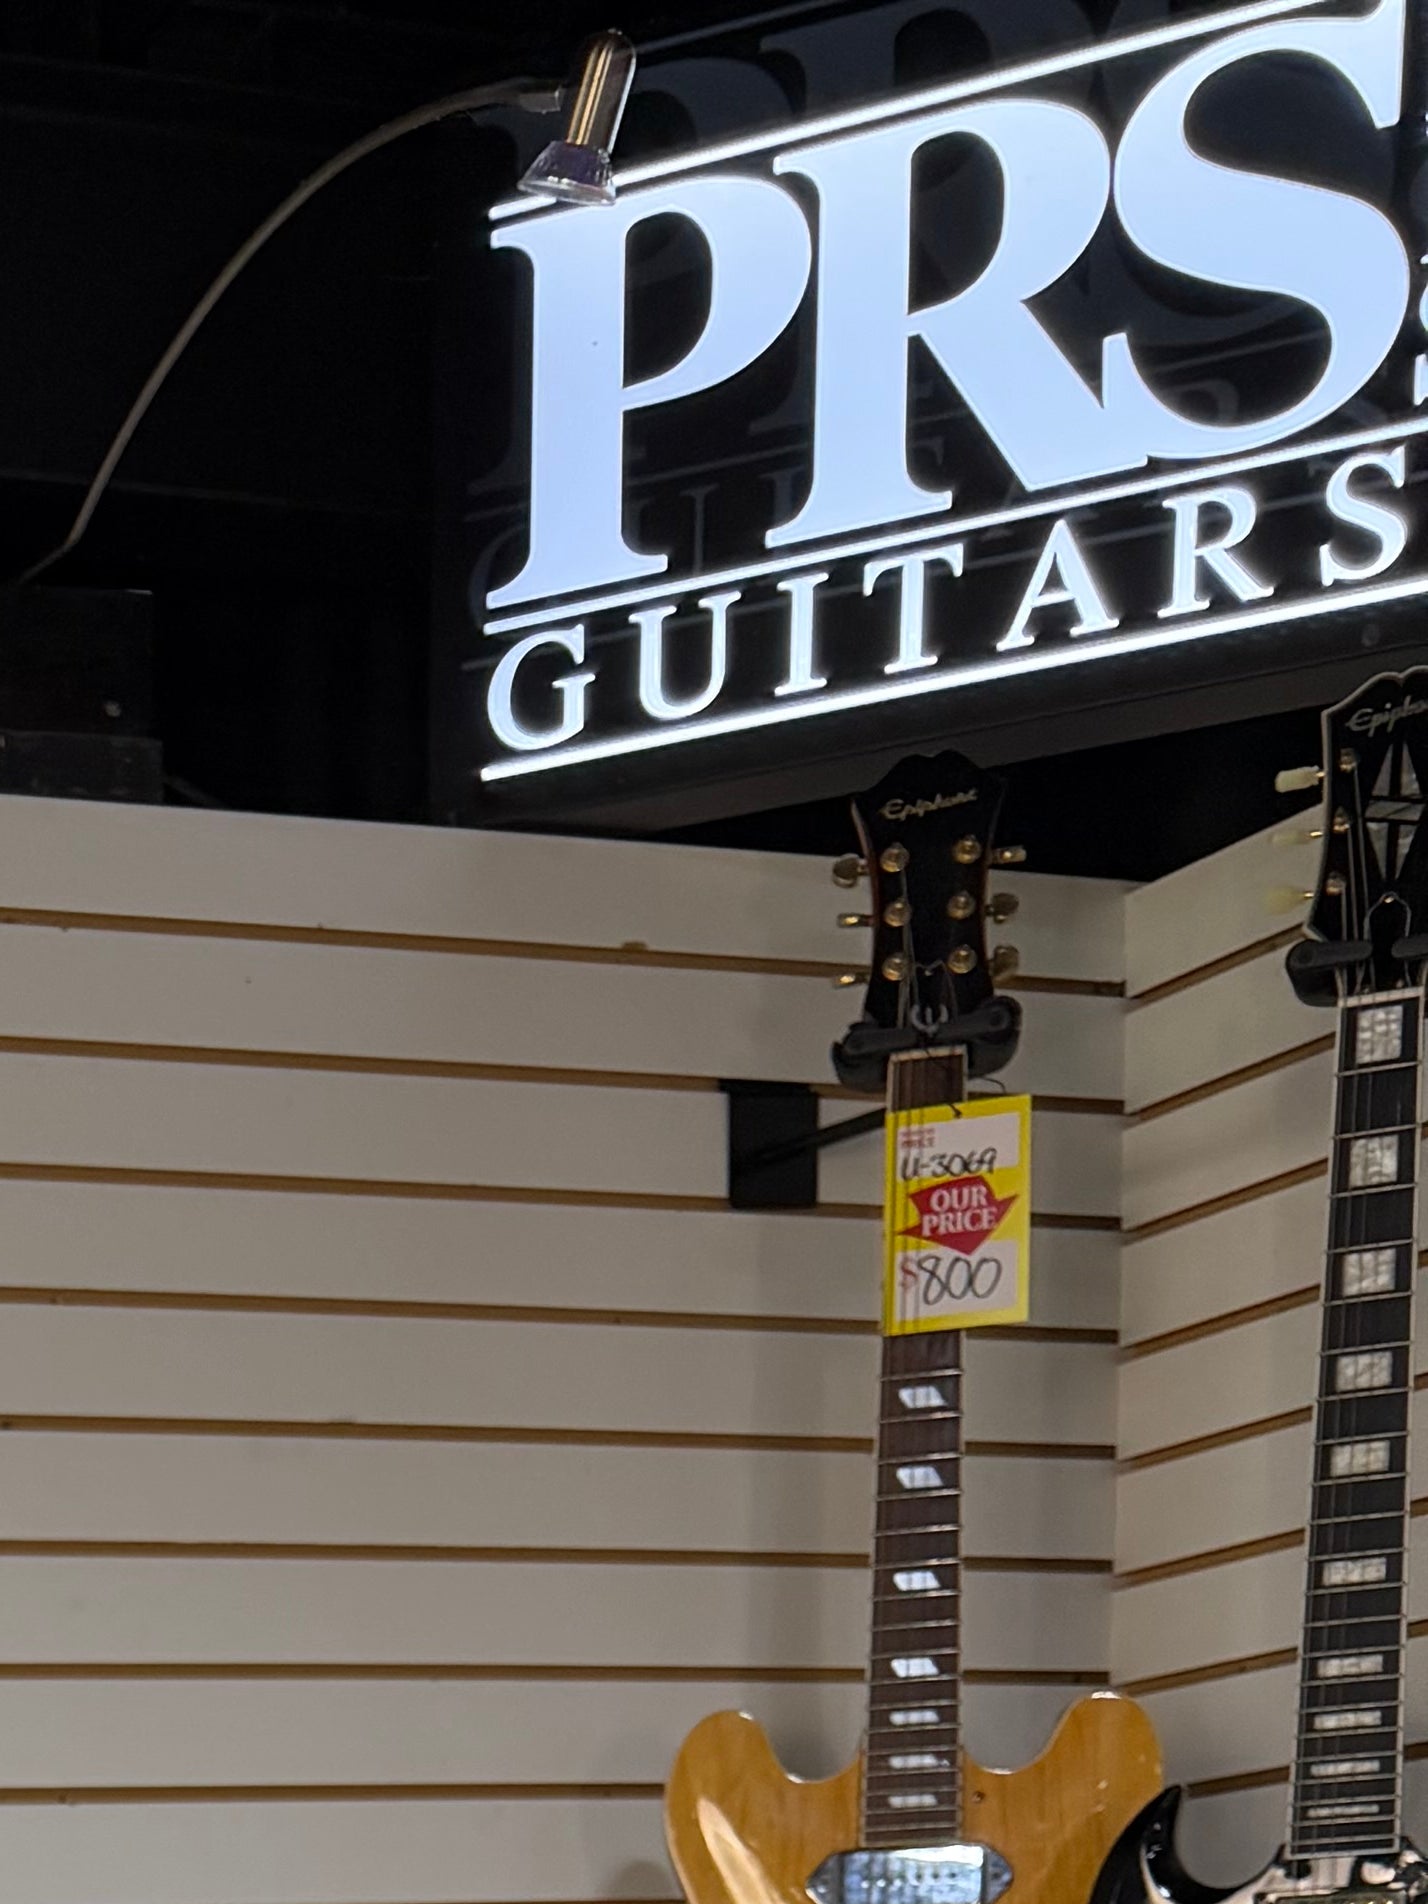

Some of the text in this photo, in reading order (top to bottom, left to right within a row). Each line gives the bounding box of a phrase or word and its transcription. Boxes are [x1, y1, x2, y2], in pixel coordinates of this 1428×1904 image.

[485, 0, 1410, 611] PRS
[485, 446, 1409, 753] GUITARS
[879, 788, 978, 822] Epiphone
[929, 1183, 989, 1212] OUR
[921, 1206, 999, 1238] PRICE
[899, 1254, 1004, 1307] $800
